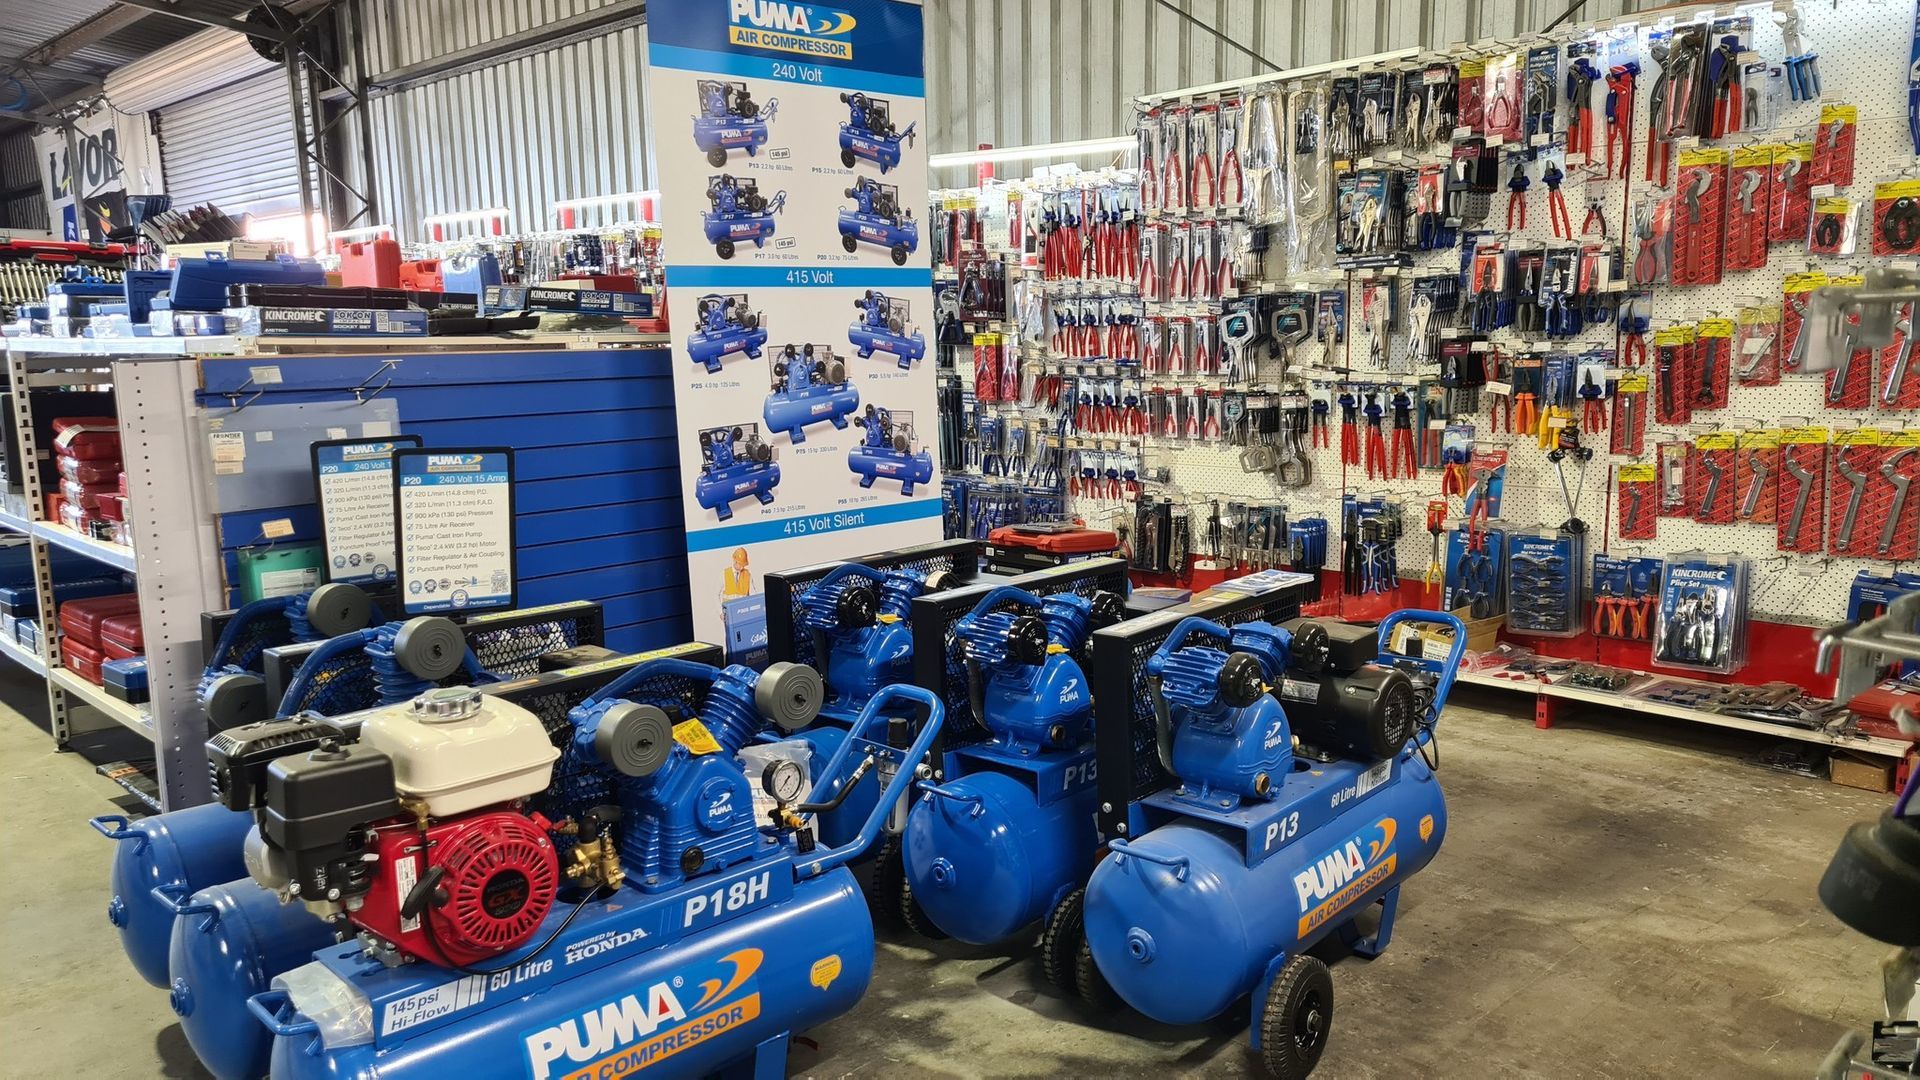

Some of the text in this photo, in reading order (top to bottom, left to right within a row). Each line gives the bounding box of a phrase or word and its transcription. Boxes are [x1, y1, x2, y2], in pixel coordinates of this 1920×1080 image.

[736, 31, 847, 57] AIR COMPRESSOR
[772, 63, 822, 82] 240 Volt
[721, 130, 742, 138] PUMA
[730, 224, 750, 232] PUMA
[786, 270, 834, 284] 415 Volt
[530, 290, 568, 300] KINCROME
[265, 310, 315, 322] KINCROME
[343, 444, 376, 455] PUMA
[428, 456, 462, 465] PUMA
[404, 477, 422, 485] P20
[457, 475, 473, 483] Volt
[486, 474, 506, 482] Amp
[784, 512, 865, 534] 415 Volt Silent
[1672, 569, 1718, 580] KINCROME
[1060, 691, 1078, 704] PUMA
[1264, 736, 1282, 750] PUMA
[1063, 758, 1098, 791] P13
[709, 803, 732, 818] PUMA
[1265, 785, 1356, 850] P13 60 Litre
[1294, 840, 1366, 913] PUMA
[684, 871, 770, 928] P18H
[1307, 864, 1389, 930] AIR COMPRESSOR
[565, 928, 648, 965] HONDA
[566, 930, 616, 952] POWERED by
[491, 959, 553, 992] 60 Litre
[392, 990, 439, 1015] 145 psi
[392, 1004, 450, 1030] Hi-Flow
[526, 981, 687, 1080] PUMA
[599, 1006, 744, 1080] COMPRESSOR
